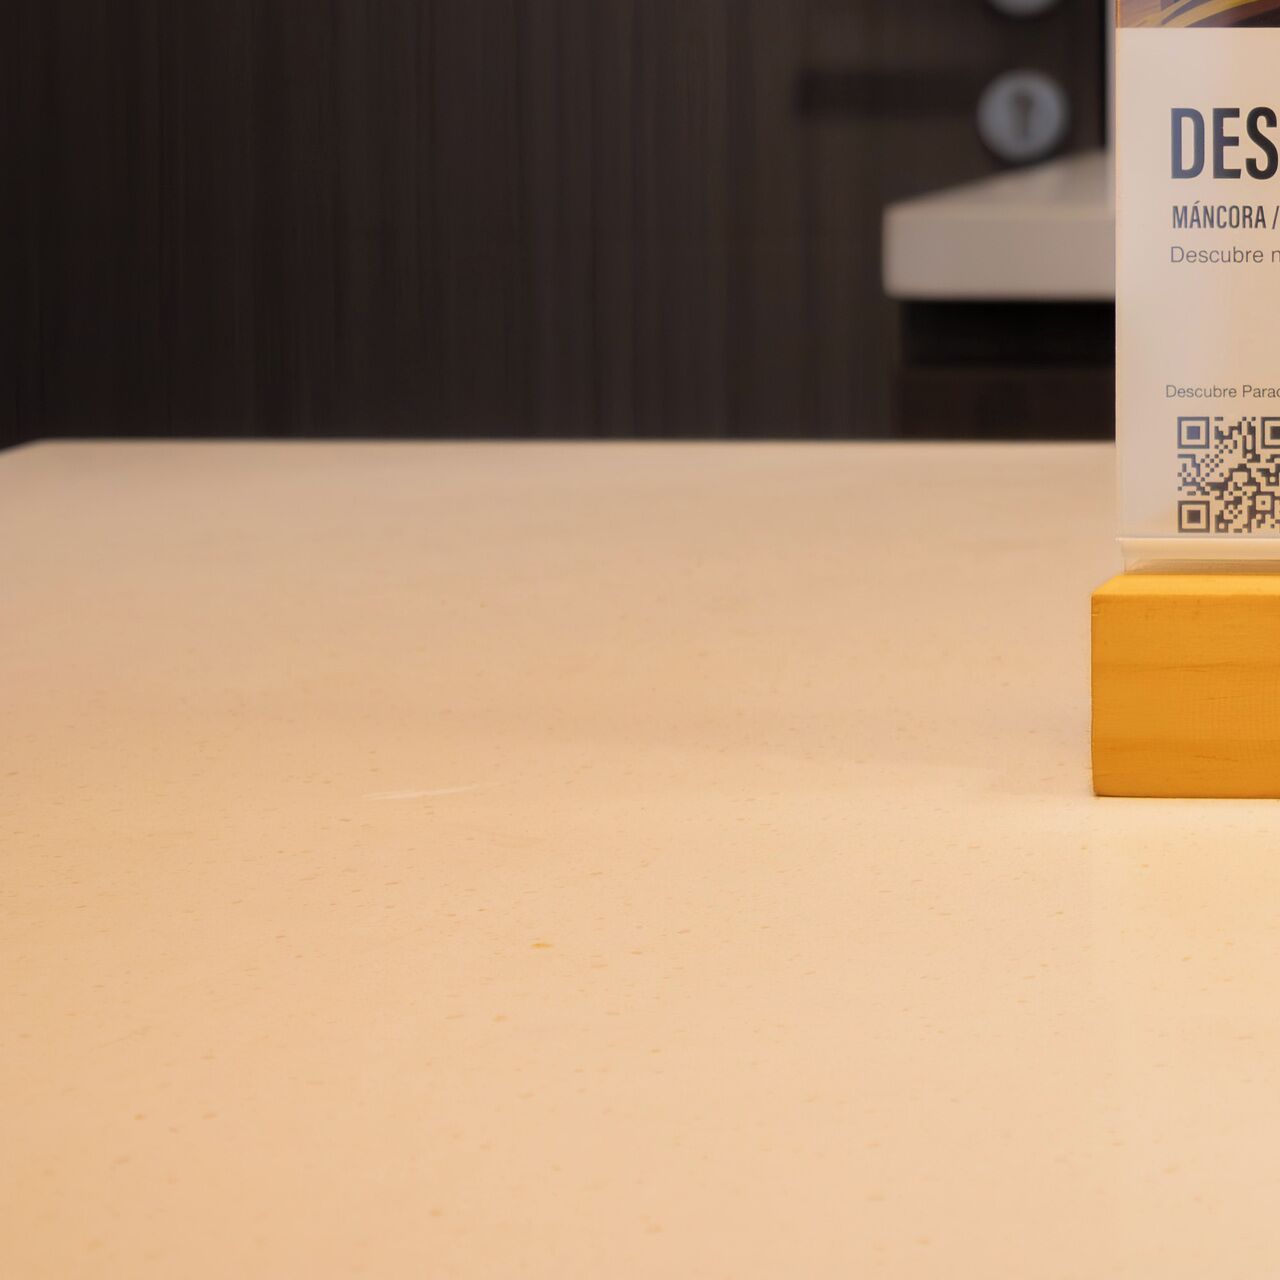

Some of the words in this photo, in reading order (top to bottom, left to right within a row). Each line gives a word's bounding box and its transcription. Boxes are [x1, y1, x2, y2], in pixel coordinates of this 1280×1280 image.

[1172, 200, 1267, 229] MÁNCORA
[1170, 245, 1264, 264] Descubre
[1166, 384, 1237, 399] Descubre
